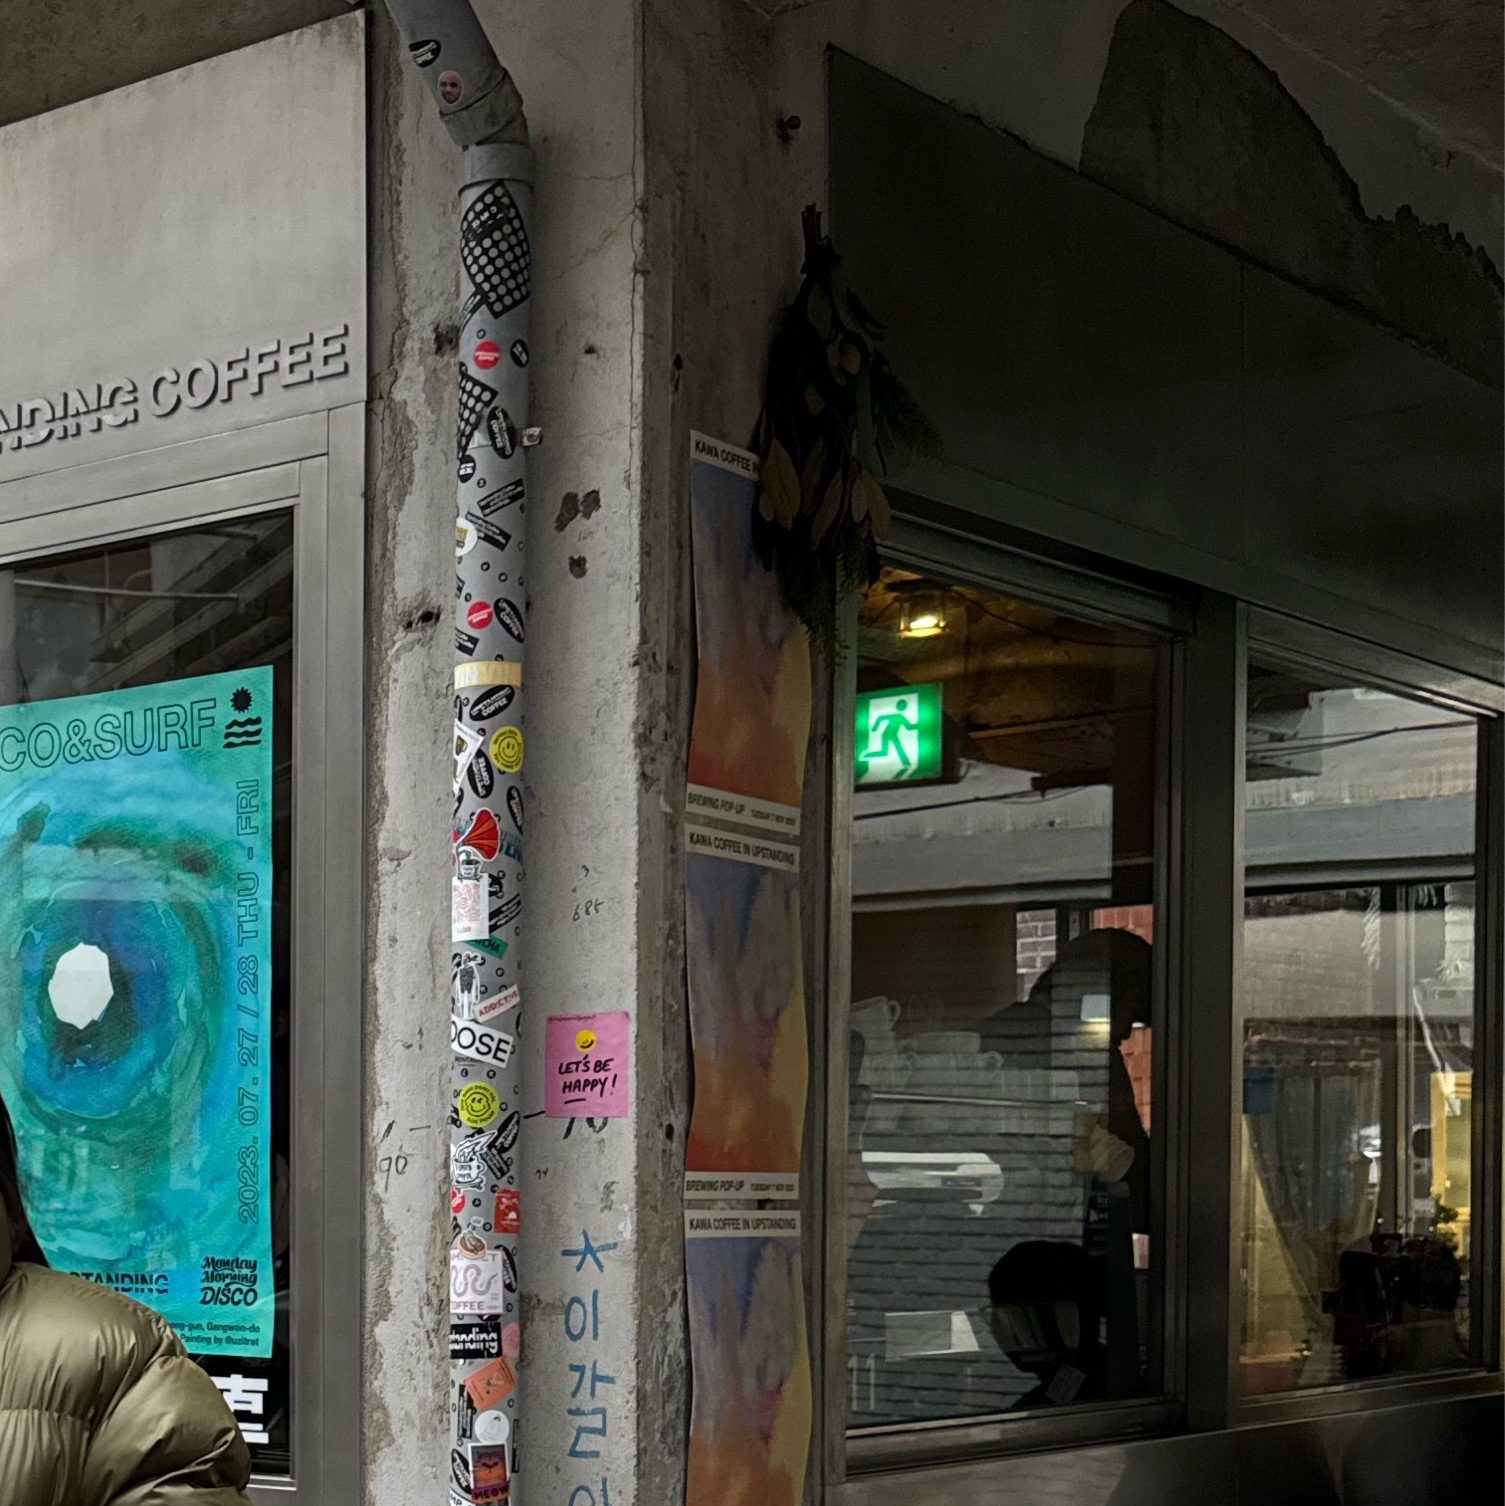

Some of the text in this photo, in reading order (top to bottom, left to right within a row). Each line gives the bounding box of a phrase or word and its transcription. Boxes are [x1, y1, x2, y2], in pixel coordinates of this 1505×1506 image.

[150, 322, 351, 418] COFFEE
[720, 449, 751, 472] COFFEE
[237, 778, 260, 836] FRI
[689, 832, 713, 847] KAWA
[713, 836, 742, 854] COFFEE
[751, 845, 795, 866] UPSTANDING
[237, 871, 260, 947] THU
[237, 954, 260, 998] 28
[237, 1027, 260, 1067] 27
[558, 1055, 615, 1075] LET'S BE
[686, 1180, 719, 1191] BREWING
[689, 1218, 796, 1231] KAWA COFFEE IN UPSTANDING
[200, 1270, 258, 1290] Morning
[199, 1286, 258, 1307] DISCO
[472, 1484, 510, 1501] MEOW
